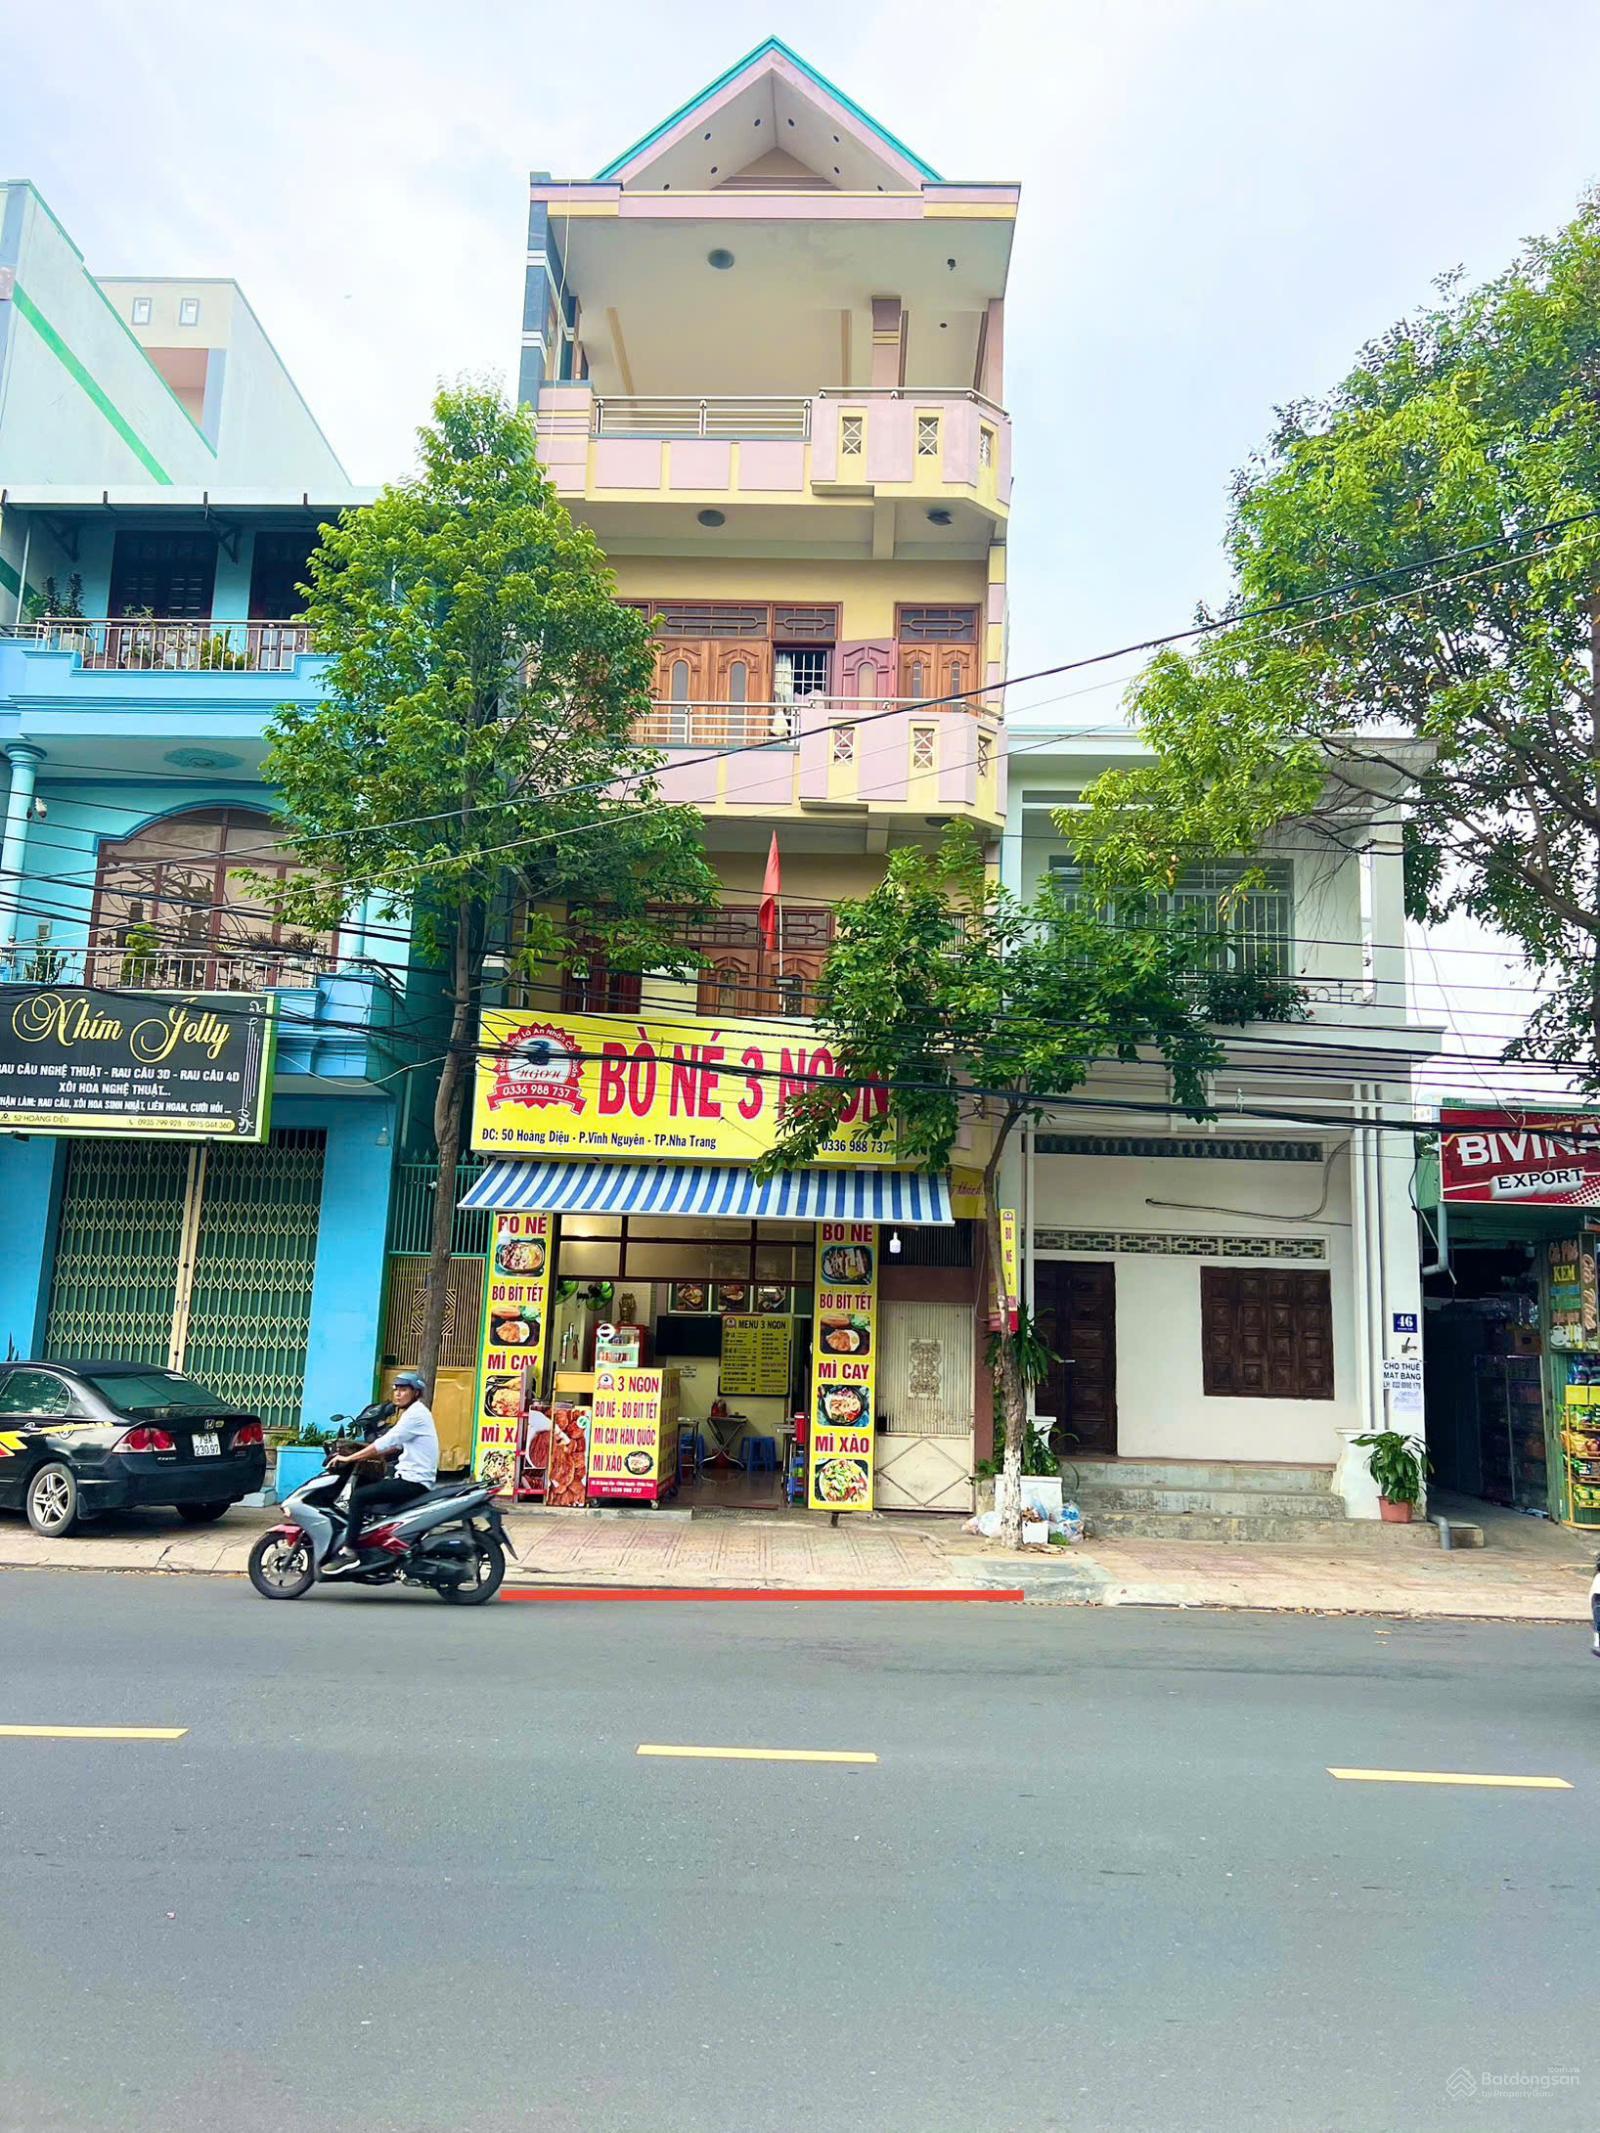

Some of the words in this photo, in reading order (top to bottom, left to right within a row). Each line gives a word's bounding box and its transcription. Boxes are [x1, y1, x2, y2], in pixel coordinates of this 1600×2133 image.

[12, 993, 124, 1047] Nhím
[130, 997, 231, 1064] Jelly
[17, 1062, 38, 1075] CÂU
[40, 1063, 68, 1079] NGHỆ
[70, 1064, 102, 1080] THUẬT
[111, 1067, 131, 1079] RAU
[134, 1066, 155, 1079] CÂU
[157, 1069, 171, 1080] 3D
[180, 1069, 201, 1081] RAU
[202, 1068, 224, 1082] CÂU
[226, 1071, 240, 1083] 4D
[598, 1027, 660, 1117] BÒ
[669, 1031, 726, 1118] NÉ
[738, 1046, 764, 1120] 3
[78, 1082, 99, 1094] HOA
[102, 1083, 130, 1097] NGHỆ
[503, 1085, 528, 1096] 0336
[530, 1085, 551, 1095] 988
[553, 1086, 571, 1098] 737
[37, 1097, 53, 1108] RAU
[482, 1127, 499, 1141] ĐC:
[502, 1128, 514, 1142] 50
[516, 1129, 546, 1145] Hoàng
[548, 1130, 570, 1146] Diệu
[579, 1131, 609, 1145] P.Vĩnh
[611, 1132, 645, 1147] Nguyên
[654, 1133, 687, 1147] TP.Nha
[689, 1135, 717, 1150] Trang
[821, 1140, 846, 1151] 0336
[849, 1140, 868, 1152] 988
[871, 1141, 889, 1153] 737
[1497, 1168, 1584, 1190] EXPORT
[525, 1212, 548, 1235] NÉ
[1553, 1264, 1576, 1281] KEM
[492, 1282, 505, 1301] BÒ
[526, 1282, 544, 1302] TẾT
[820, 1292, 833, 1309] BÒ
[854, 1291, 873, 1311] TẾT
[738, 1320, 759, 1329] MENU
[760, 1320, 766, 1329] 3
[1397, 1315, 1413, 1327] 46
[488, 1351, 506, 1370] MÌ
[818, 1359, 837, 1379] MÌ
[842, 1363, 870, 1380] CAY
[1384, 1362, 1400, 1370] CHO
[618, 1375, 625, 1392] 3
[629, 1376, 659, 1393] NGON
[481, 1423, 500, 1443] MÌ
[815, 1432, 834, 1452] MÌ
[839, 1433, 870, 1454] XÀO
